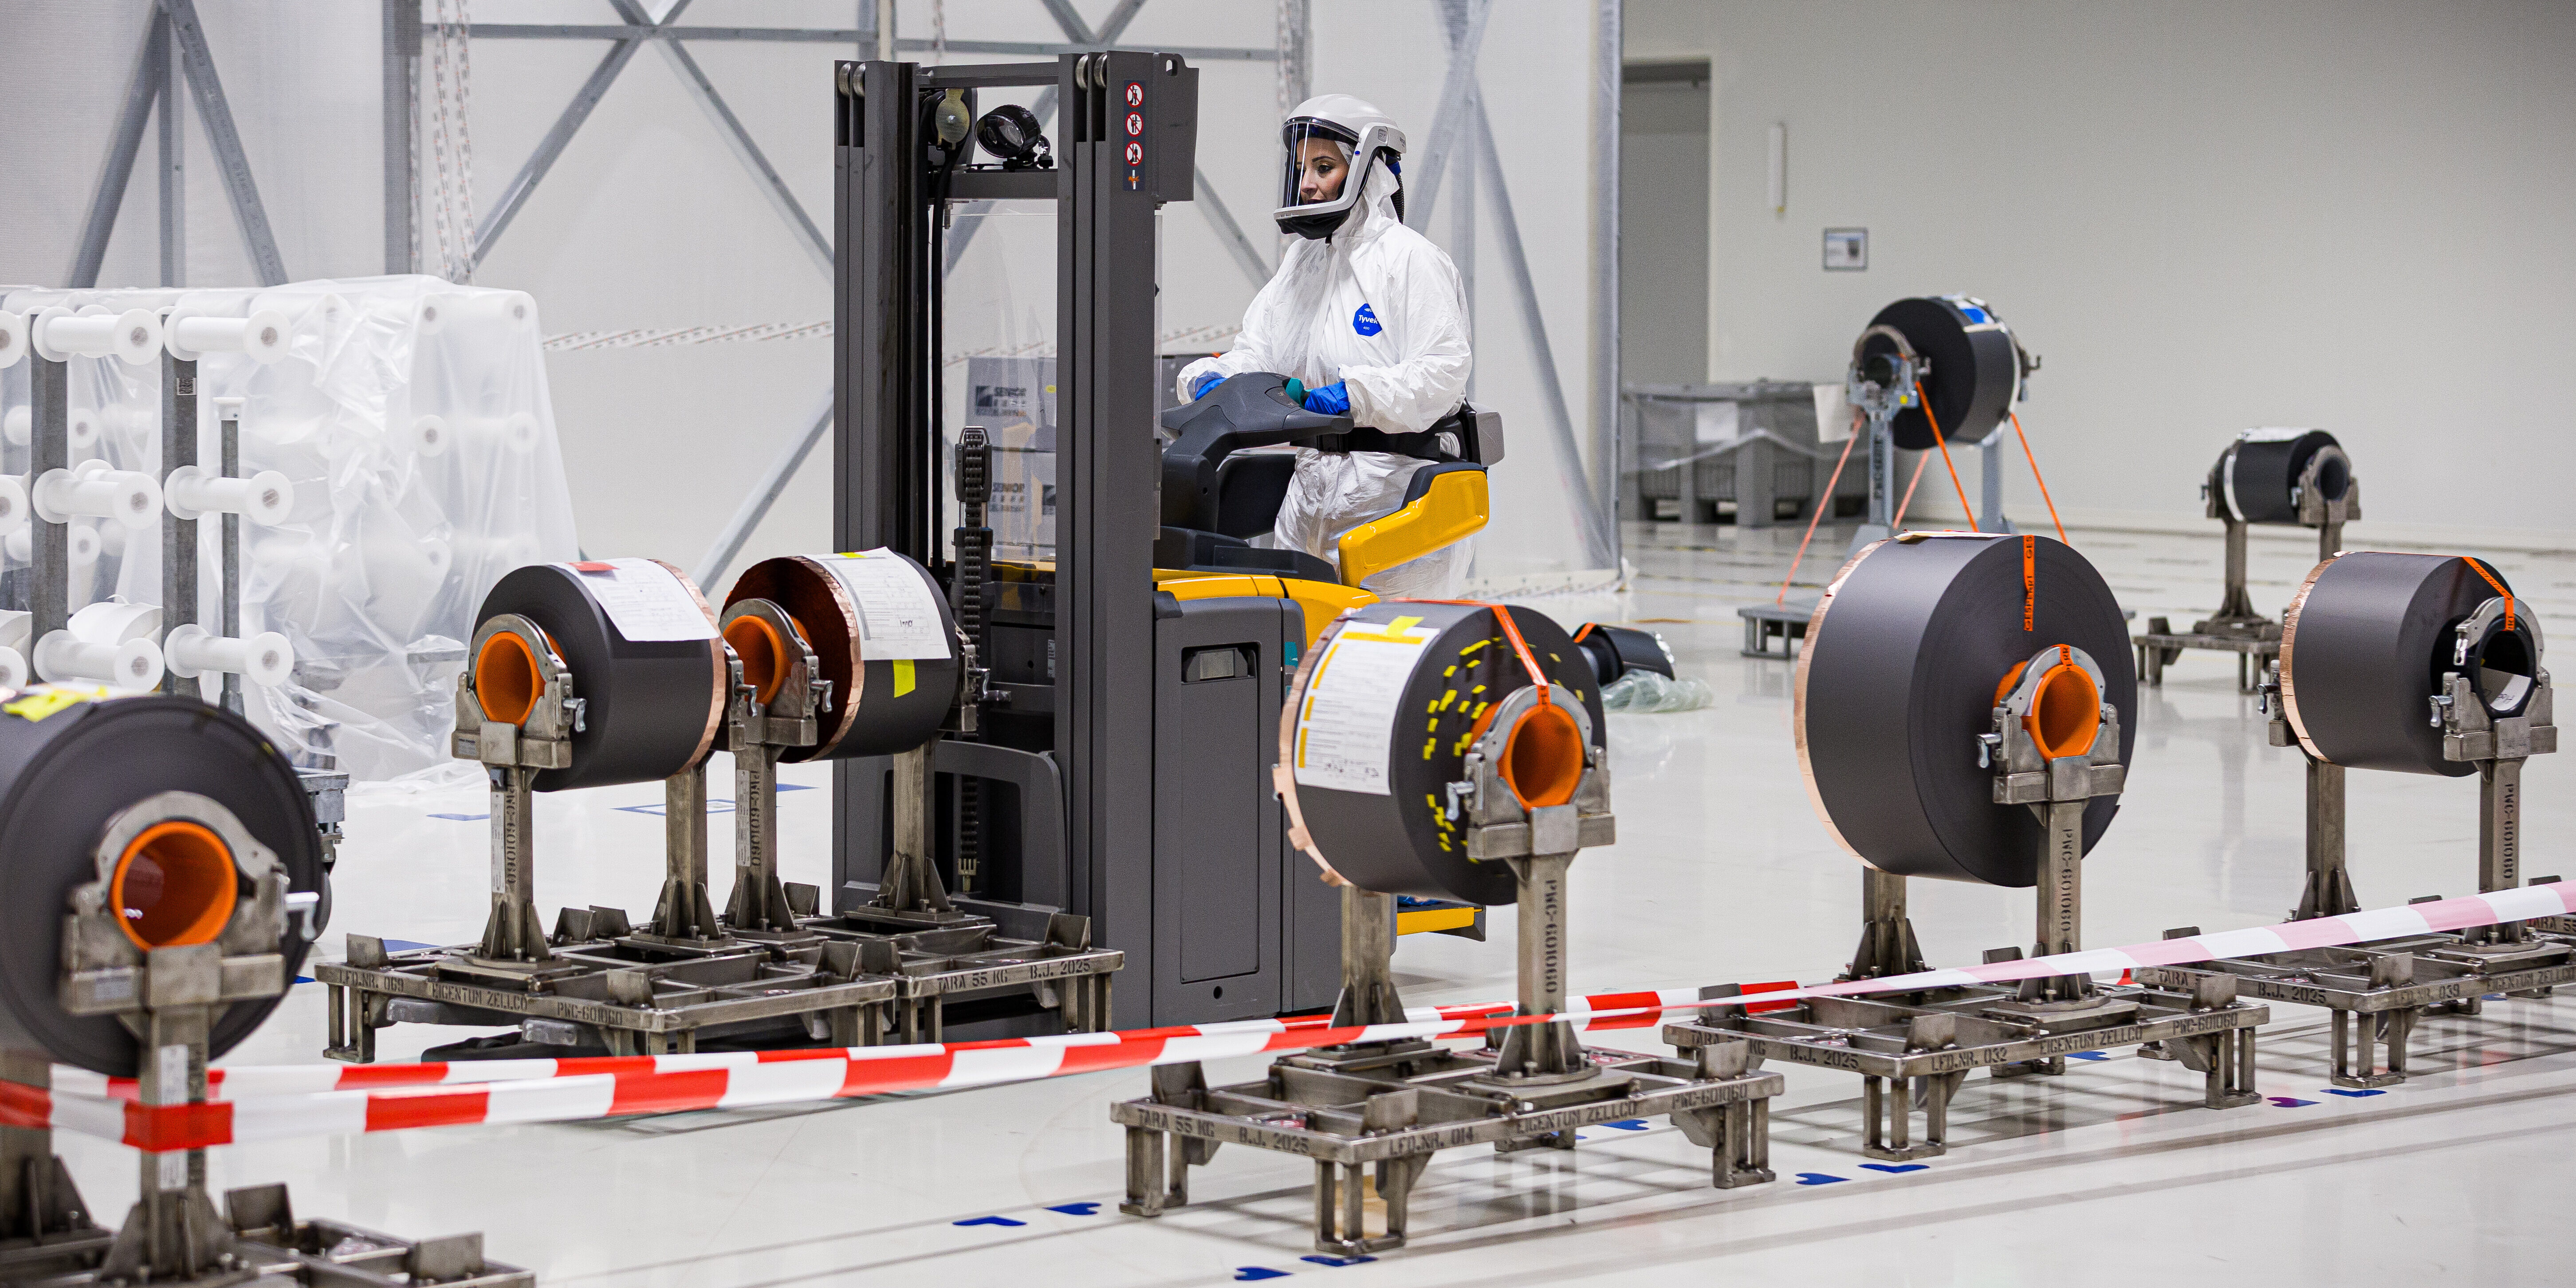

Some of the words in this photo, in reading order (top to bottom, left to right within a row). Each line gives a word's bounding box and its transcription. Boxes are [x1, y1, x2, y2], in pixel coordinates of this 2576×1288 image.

[1358, 314, 1378, 324] Tyvek
[937, 975, 966, 991] TARA
[972, 972, 988, 987] 55
[993, 970, 1009, 984] KG
[1030, 963, 1054, 979] B.J.
[1060, 958, 1091, 975] 2025
[2158, 969, 2189, 987] TARA
[2258, 982, 2285, 999] B.J.
[2291, 986, 2327, 1004] 2025
[1790, 1045, 1817, 1063] B.J.
[1823, 1049, 1859, 1069] 2025
[1984, 1046, 2007, 1064] 032
[2041, 1033, 2095, 1055] EIGENTUM
[2099, 1025, 2143, 1046] ZELLCO
[1138, 1108, 1170, 1130] TARA
[1176, 1115, 1193, 1133] 55
[1273, 1132, 1310, 1153] 2025
